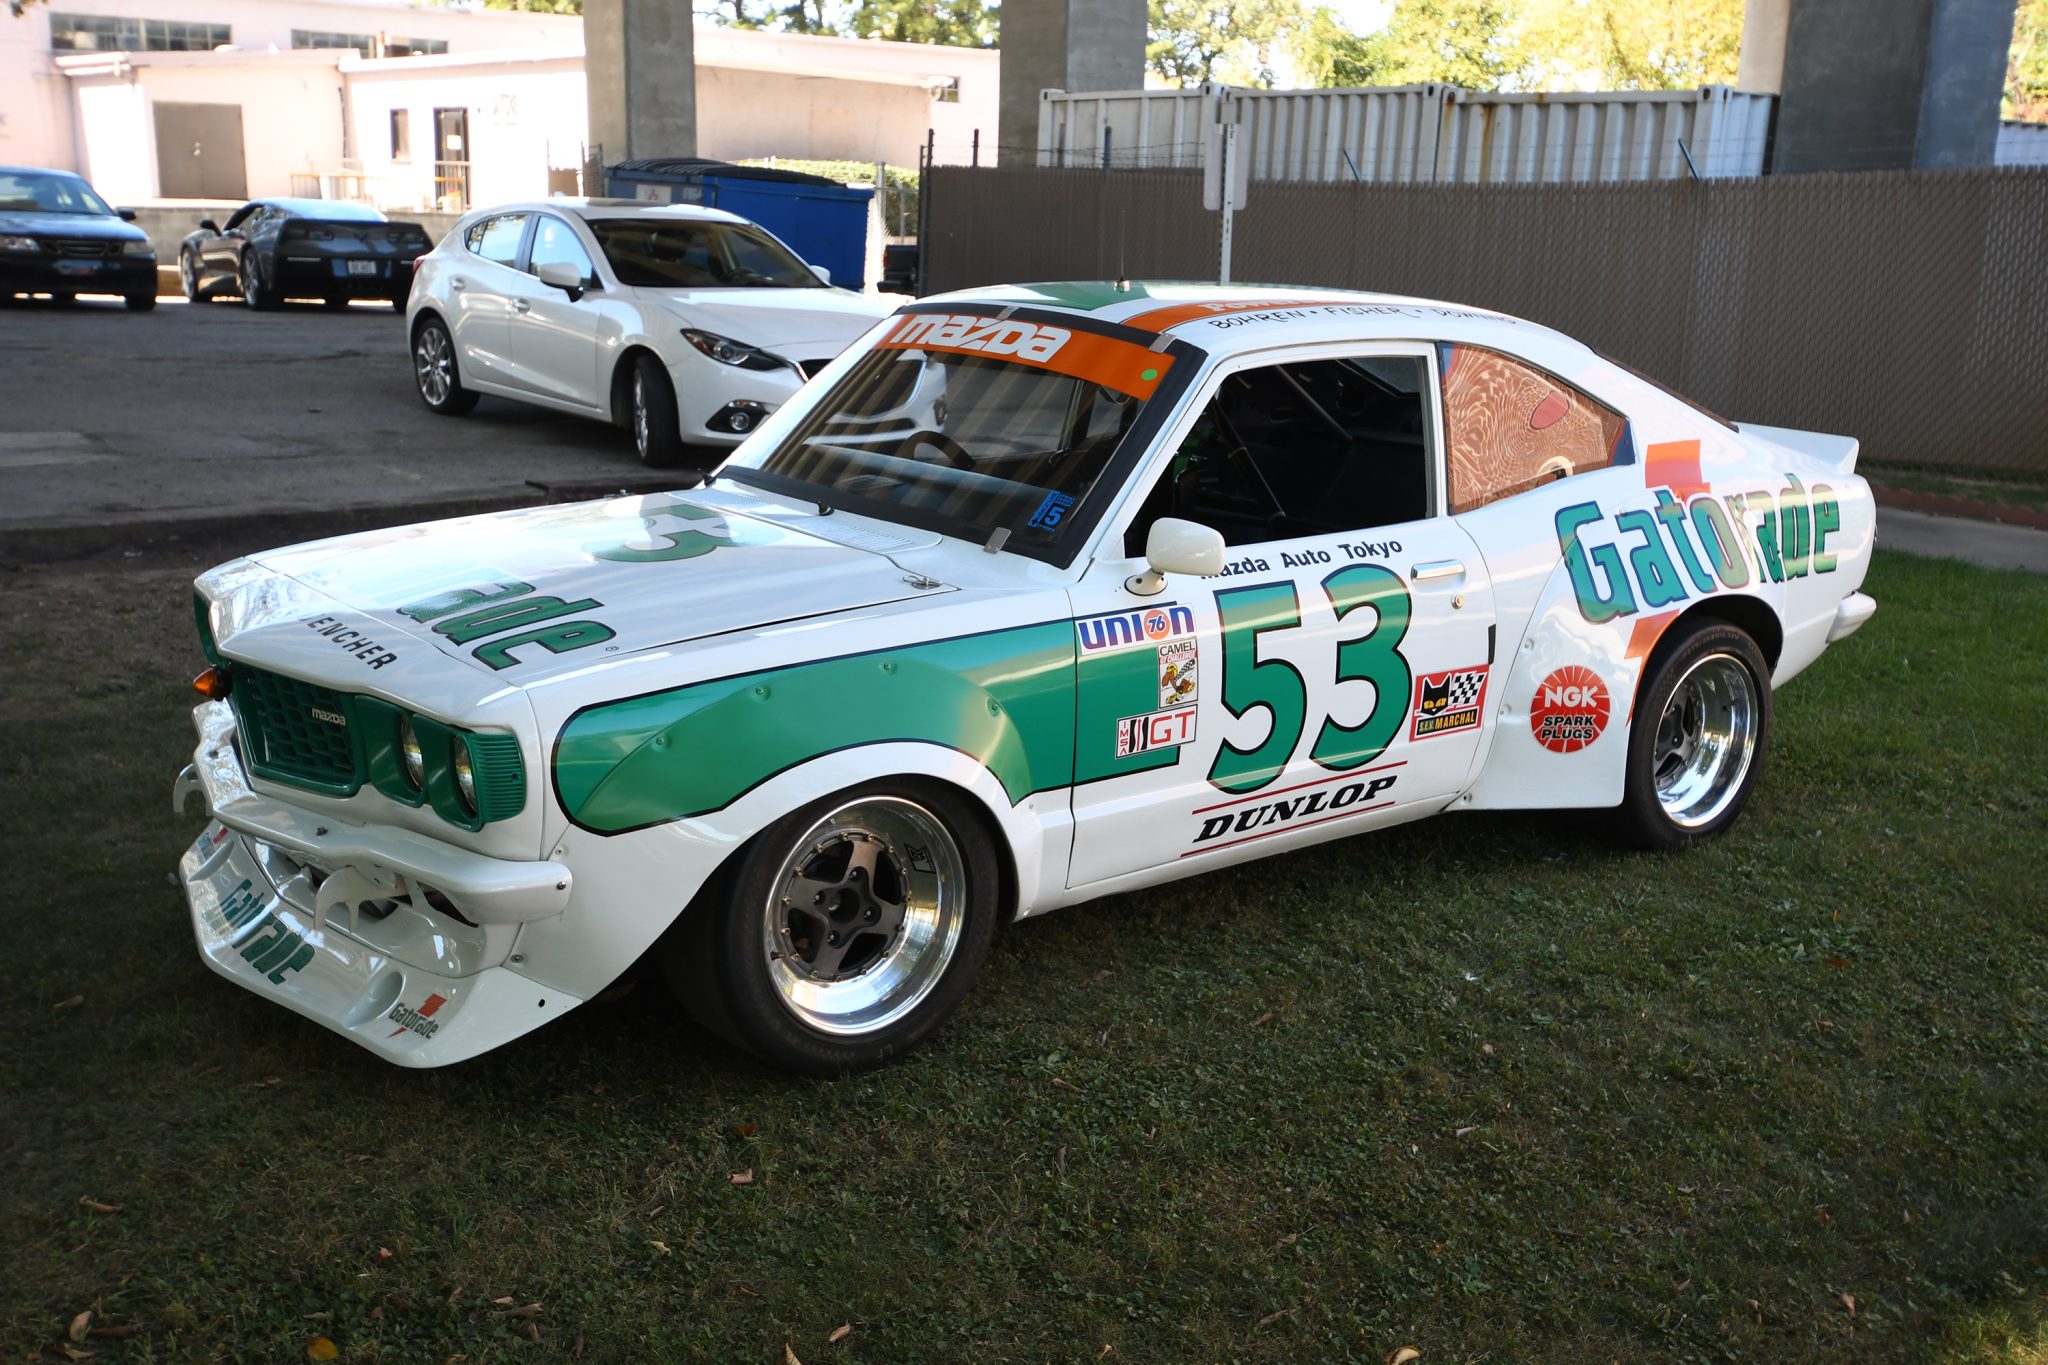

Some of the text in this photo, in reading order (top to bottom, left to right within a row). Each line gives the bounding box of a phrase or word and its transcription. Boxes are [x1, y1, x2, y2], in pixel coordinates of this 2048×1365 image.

[1209, 310, 1305, 329] BOHREN
[1324, 307, 1419, 319] FISHER
[889, 314, 1072, 363] mazda
[1200, 540, 1403, 580] azda Auto Tokyo
[1554, 472, 1840, 625] Gatorade
[1148, 615, 1166, 633] 76
[1159, 640, 1196, 657] CAMEL
[1205, 562, 1413, 795] 53
[1544, 685, 1598, 708] NGK
[311, 708, 347, 727] mazda
[1150, 711, 1195, 745] GT
[1435, 711, 1475, 730] MARCHAL
[1543, 714, 1596, 727] SPARK
[1119, 721, 1129, 756] IMSA
[1540, 727, 1594, 740] PLUGS
[1192, 775, 1398, 843] DUNLOP
[388, 1002, 439, 1040] Gatorade
